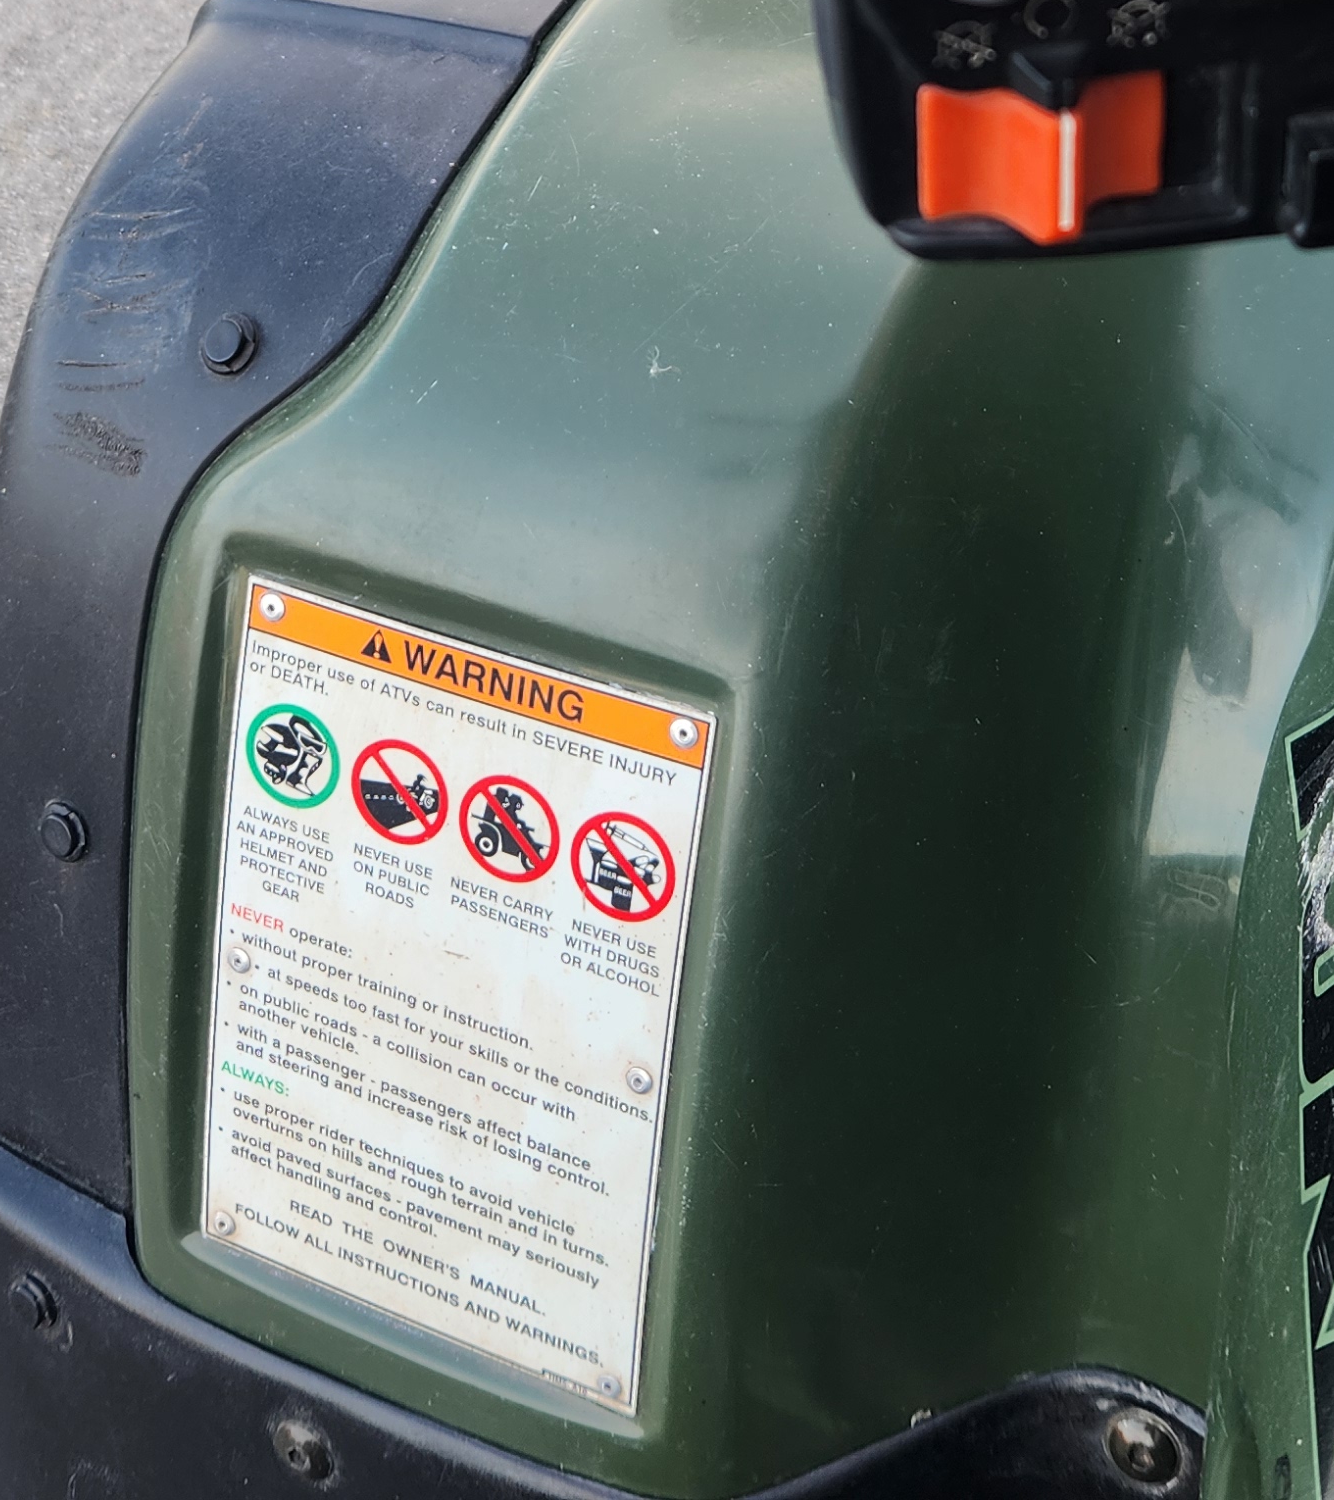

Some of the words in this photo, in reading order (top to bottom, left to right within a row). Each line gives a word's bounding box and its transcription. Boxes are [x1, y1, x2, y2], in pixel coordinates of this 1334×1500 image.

[249, 661, 266, 675] or
[271, 664, 328, 696] DEATH.
[404, 640, 584, 723] WARNING
[252, 640, 322, 674] Improper
[327, 667, 355, 685] use
[360, 679, 376, 692] of
[380, 683, 420, 707] ATVs
[426, 700, 454, 718] can
[460, 711, 506, 735] result
[512, 723, 527, 741] in
[532, 730, 604, 765] SEVERE
[609, 753, 677, 786] INJURY
[236, 820, 255, 836] AN
[258, 828, 334, 862] APPROVED
[243, 805, 298, 833] ALWAYS
[302, 824, 329, 844] USE
[240, 837, 295, 866] HELMET
[297, 858, 328, 877] AND
[240, 854, 325, 895] PROTECTIVE
[353, 842, 401, 869] NEVER
[404, 860, 433, 880] USE
[353, 860, 374, 877] ON
[378, 868, 430, 896] PUBLIC
[262, 880, 300, 903] GEAR
[365, 881, 414, 909] ROADS
[450, 876, 498, 903] NEVER
[502, 895, 553, 921] CARRY
[613, 885, 632, 898] BEER
[231, 902, 284, 933] NEVER
[289, 927, 352, 959] operate:
[450, 894, 548, 939] PASSENGERS
[571, 918, 622, 947] NEVER
[626, 937, 657, 959] USE
[560, 952, 582, 969] OR
[586, 961, 660, 998] ALCOHOL
[564, 934, 602, 958] WITH
[606, 948, 660, 979] DRUGS
[242, 932, 297, 962] without
[301, 955, 353, 982] proper
[358, 974, 417, 1009] training
[422, 1000, 439, 1014] or
[443, 1005, 533, 1051] instruction.
[238, 1000, 296, 1030] another
[300, 1024, 359, 1055] vehicle.
[267, 968, 281, 982] at
[285, 975, 339, 1003] speeds
[343, 994, 367, 1014] too
[372, 1005, 399, 1027] fast
[404, 1017, 426, 1035] for
[430, 1029, 464, 1050] your
[468, 1044, 509, 1068] skills
[513, 1061, 530, 1076] or
[534, 1067, 560, 1087] the
[564, 1081, 653, 1123] conditions.
[240, 984, 258, 1000] on
[263, 993, 309, 1019] public
[314, 1012, 357, 1037] roads
[372, 1035, 381, 1047] a
[386, 1040, 452, 1074] collision
[457, 1068, 486, 1087] can
[491, 1081, 537, 1106] occur
[542, 1100, 575, 1122] with
[221, 1060, 289, 1097] ALWAYS:
[237, 1024, 268, 1044] with
[272, 1038, 281, 1050] a
[285, 1043, 366, 1082] passenger
[380, 1080, 472, 1125] passengers
[476, 1118, 522, 1145] affect
[526, 1135, 591, 1171] balance
[236, 1040, 264, 1059] and
[268, 1053, 330, 1088] steering
[334, 1079, 363, 1099] and
[367, 1089, 434, 1126] increase
[438, 1119, 468, 1140] risk
[472, 1134, 489, 1148] of
[493, 1138, 543, 1172] losing
[547, 1163, 609, 1197] control.
[234, 1090, 260, 1109] use
[264, 1103, 315, 1131] proper
[319, 1125, 355, 1146] rider
[359, 1139, 445, 1184] techniques
[449, 1175, 464, 1192] to
[469, 1186, 513, 1212] avoid
[517, 1205, 575, 1236] vehicle
[231, 1145, 272, 1170] affect
[276, 1160, 341, 1201] handling
[345, 1192, 374, 1212] and
[378, 1205, 437, 1238] control.
[231, 1129, 272, 1154] avoid
[276, 1147, 321, 1174] paved
[326, 1168, 391, 1202] surfaces
[406, 1200, 483, 1241] pavement
[487, 1234, 521, 1257] may
[525, 1249, 599, 1289] seriously
[233, 1107, 303, 1143] overturns
[308, 1137, 327, 1152] on
[332, 1143, 363, 1167] hills
[367, 1161, 396, 1181] and
[401, 1174, 447, 1201] rough
[451, 1192, 503, 1224] terrain
[508, 1218, 538, 1238] and
[543, 1229, 558, 1246] in
[562, 1237, 609, 1267] turns.
[290, 1199, 333, 1227] READ
[342, 1221, 374, 1245] THE
[383, 1239, 460, 1280] OWNER'S
[470, 1274, 547, 1317] MANUAL.
[235, 1203, 300, 1239] FOLLOW
[303, 1233, 333, 1255] ALL
[338, 1246, 460, 1307] INSTRUCTIONS
[464, 1300, 501, 1323] AND
[505, 1316, 604, 1368] WARNINGS.
